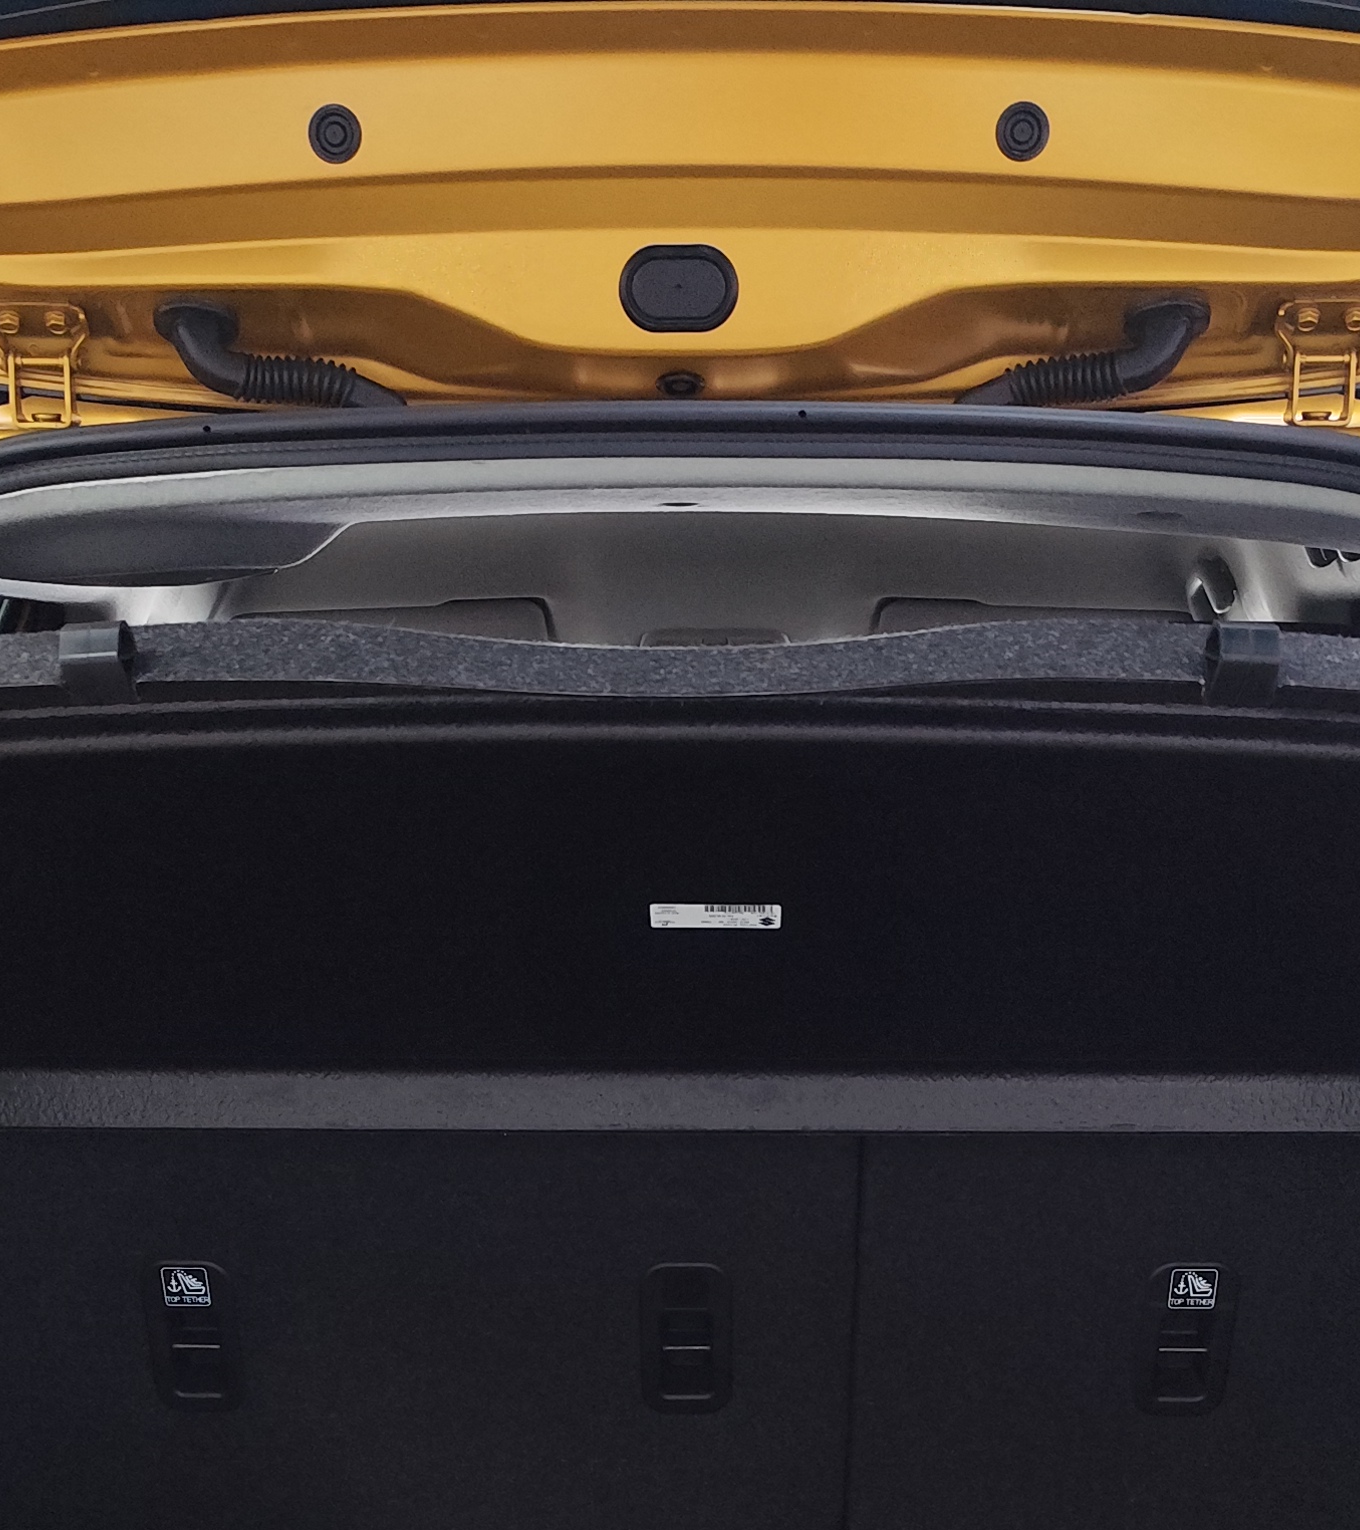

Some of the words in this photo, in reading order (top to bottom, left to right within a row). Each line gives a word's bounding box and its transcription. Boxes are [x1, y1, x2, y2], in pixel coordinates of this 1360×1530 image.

[165, 1295, 181, 1303] TOP
[181, 1295, 210, 1304] TETHER
[1170, 1298, 1185, 1306] TOP
[1186, 1298, 1215, 1306] TETHER
